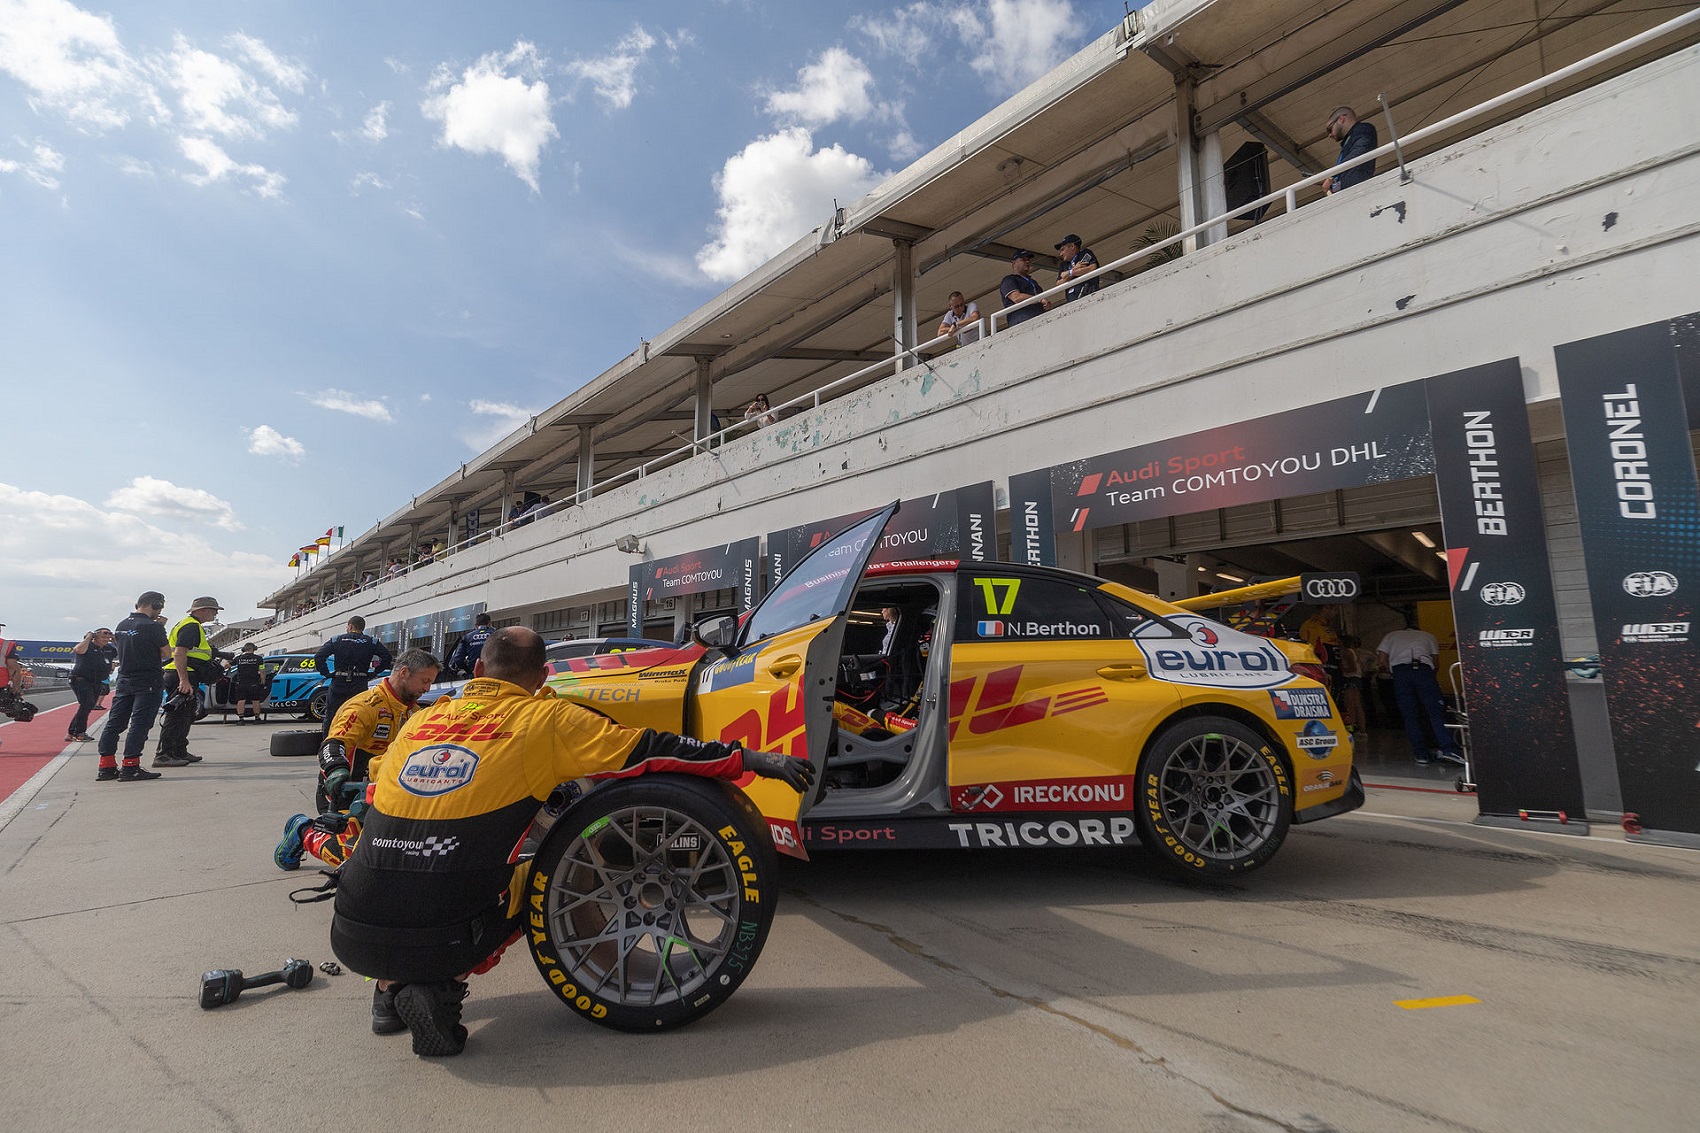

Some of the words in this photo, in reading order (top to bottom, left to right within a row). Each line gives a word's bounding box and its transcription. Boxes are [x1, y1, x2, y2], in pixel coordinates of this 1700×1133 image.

[1602, 383, 1657, 519] CORONEL
[1106, 462, 1160, 487] Audi
[1167, 445, 1245, 475] Sport
[1106, 484, 1165, 507] Team
[1172, 452, 1321, 496] COMTOYOU
[1331, 440, 1387, 467] DHL
[1463, 410, 1508, 536] BERTHON
[663, 566, 679, 577] Audi
[680, 561, 702, 573] Sport
[890, 558, 956, 569] Challengers
[662, 577, 681, 589] Team
[681, 569, 723, 585] COMTOYOU
[1623, 575, 1672, 592] FIA
[973, 577, 1021, 615] 17
[1482, 586, 1521, 602] FIA
[1007, 620, 1100, 637] N.Berthon
[300, 658, 316, 669] 68
[1155, 646, 1279, 672] eurol
[1179, 671, 1274, 680] LUBRICANTS
[470, 711, 507, 722] Sport
[1293, 706, 1331, 718] DRAISMA
[407, 722, 507, 742] DHL
[1299, 738, 1314, 746] ASC
[1314, 737, 1337, 746] Group
[406, 760, 471, 779] eurol
[1259, 745, 1290, 796] EAGLE
[1014, 784, 1125, 804] IRECKONU
[820, 826, 896, 845] Sport
[948, 817, 1136, 848] TRICORP
[371, 836, 424, 852] comtoyou
[717, 824, 760, 904] EAGLE
